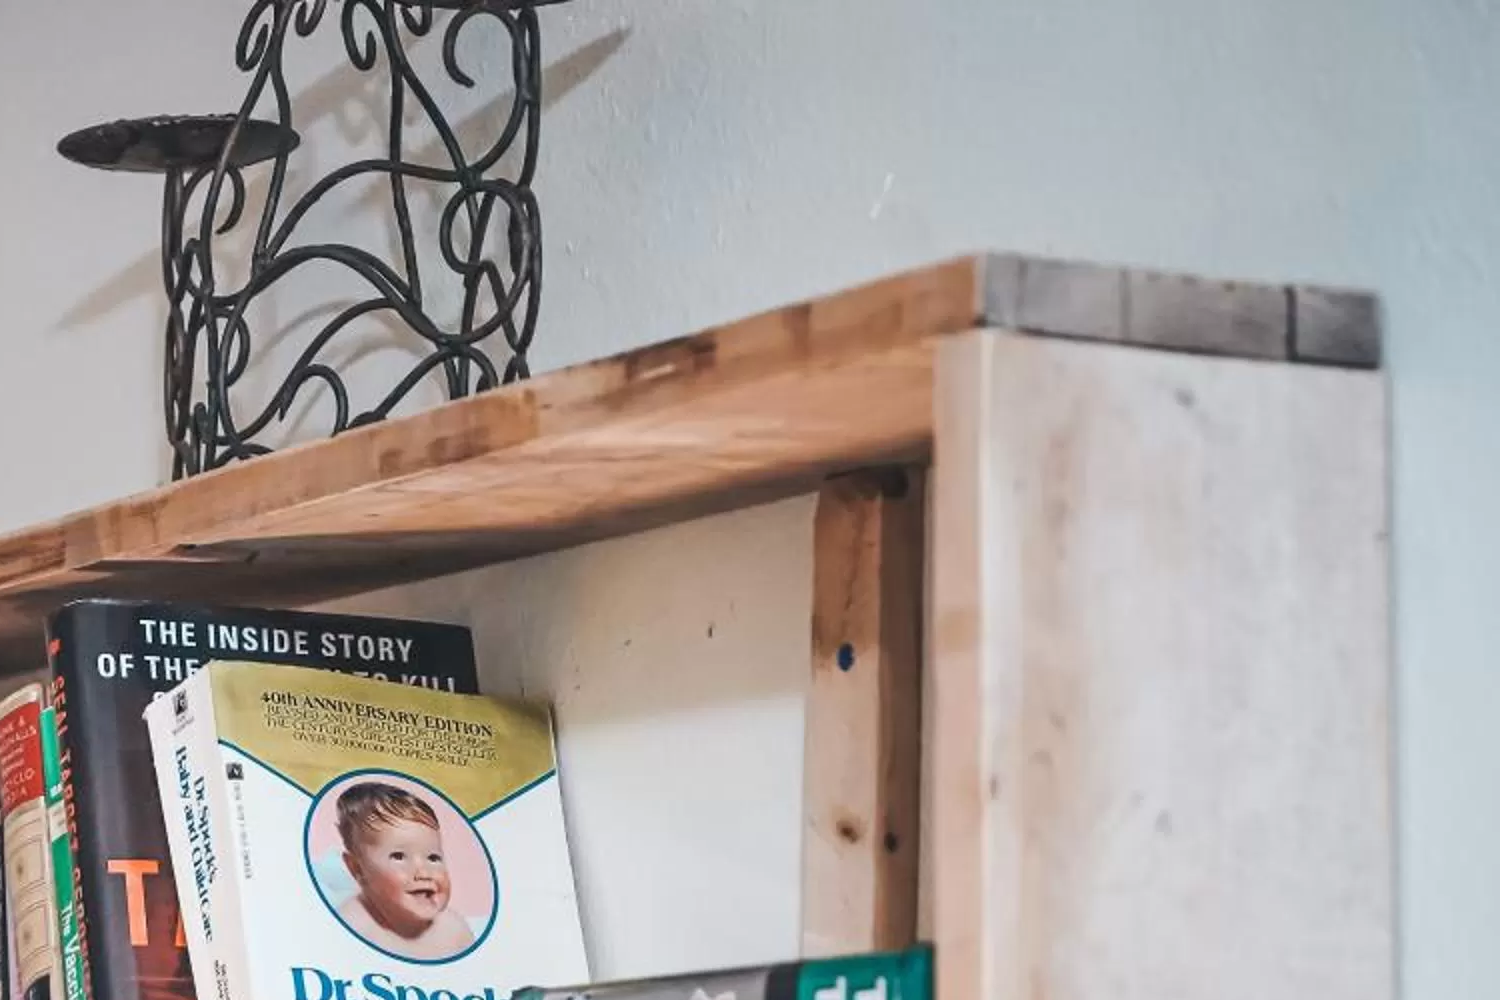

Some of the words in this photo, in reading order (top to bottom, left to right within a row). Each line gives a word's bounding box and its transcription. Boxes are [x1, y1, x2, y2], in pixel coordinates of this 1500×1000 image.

[140, 619, 197, 648] THE
[208, 623, 309, 656] INSIDE
[321, 632, 413, 663] STORY
[98, 653, 136, 679] OF
[144, 656, 201, 682] THE
[261, 691, 298, 707] 40th
[303, 695, 420, 727] ANNIVERSARY
[423, 715, 493, 737] EDITION
[175, 746, 192, 799] Baby
[183, 803, 199, 843] and
[196, 805, 218, 884] Spock's
[191, 846, 208, 900] Child
[60, 900, 73, 936] The
